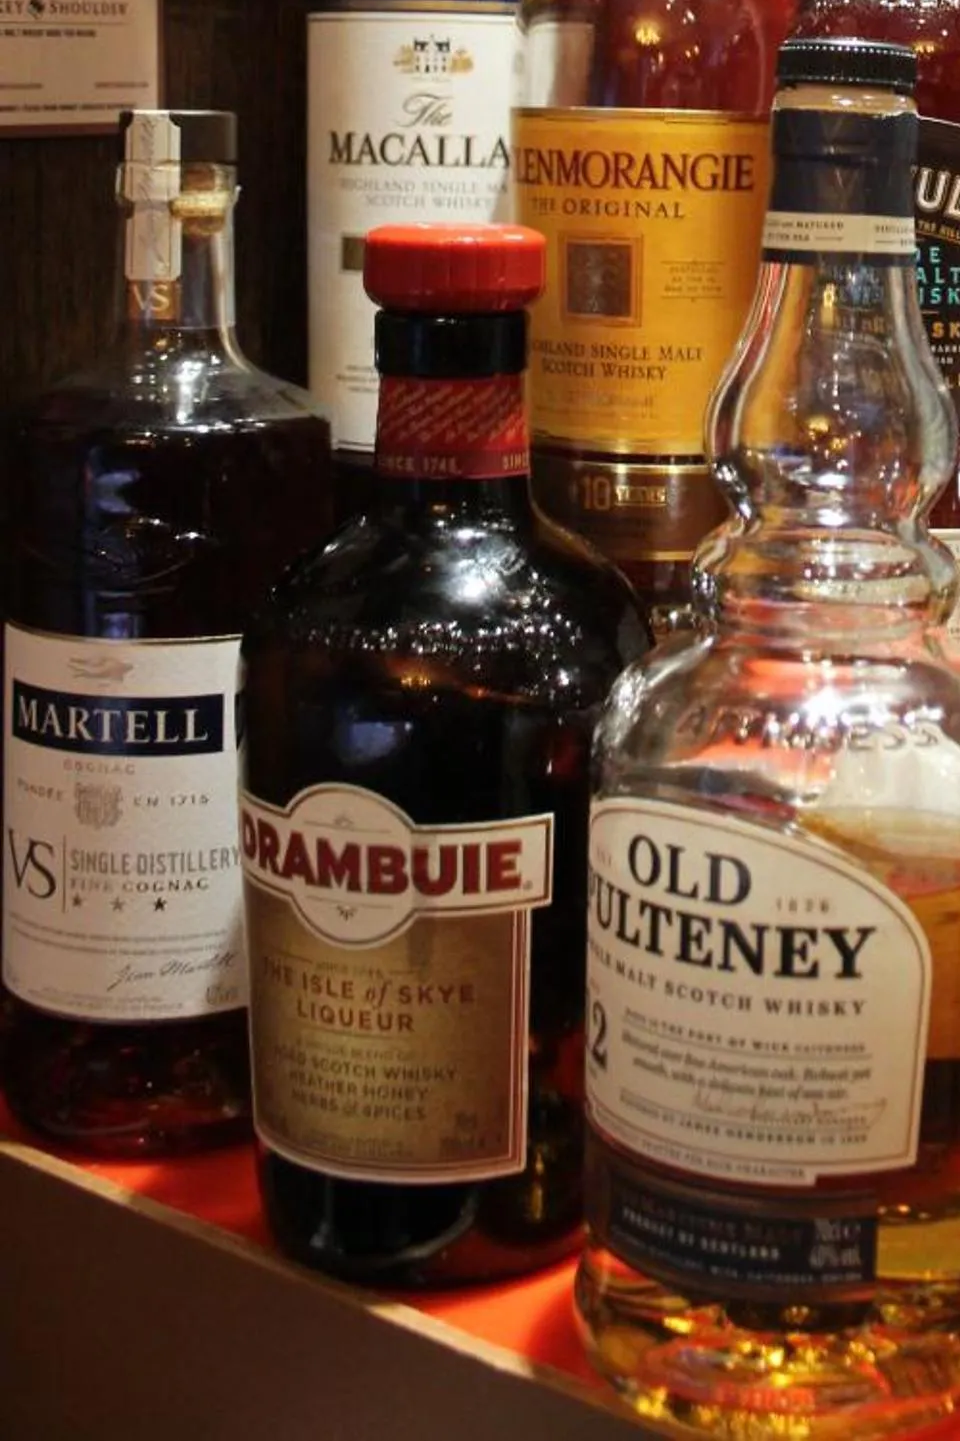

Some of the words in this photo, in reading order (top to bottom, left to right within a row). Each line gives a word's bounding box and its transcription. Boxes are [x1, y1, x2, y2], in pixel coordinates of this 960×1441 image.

[395, 93, 453, 128] The
[329, 129, 511, 170] MACALLA
[514, 146, 756, 193] LENMORANGIE
[365, 195, 426, 209] SCOTCH
[562, 198, 686, 220] ORIGINAL
[590, 342, 650, 362] SINGLE
[657, 346, 705, 361] MALT
[600, 362, 669, 380] WHISKY
[581, 476, 612, 511] 10
[18, 693, 209, 745] MARTELL
[62, 757, 136, 777] COGNAC
[7, 827, 58, 900] VS
[70, 846, 131, 877] SINGLE
[242, 808, 523, 897] DRAMBUIE
[627, 833, 752, 907] OLD
[121, 877, 209, 894] COGNAC
[263, 956, 294, 986] THE
[301, 970, 355, 1000] ISLE
[364, 980, 393, 1011] of
[397, 982, 477, 1005] SKYE
[615, 960, 658, 992] MALT
[664, 980, 753, 1013] SCOTCH
[763, 998, 867, 1016] WHISKY
[296, 997, 415, 1033] LIQUEUR
[289, 1069, 359, 1096] HEATHER
[362, 1081, 430, 1102] HONEY
[311, 1057, 376, 1080] SCOTCH
[383, 1065, 458, 1081] WHISKY
[362, 1103, 428, 1121] SPICES
